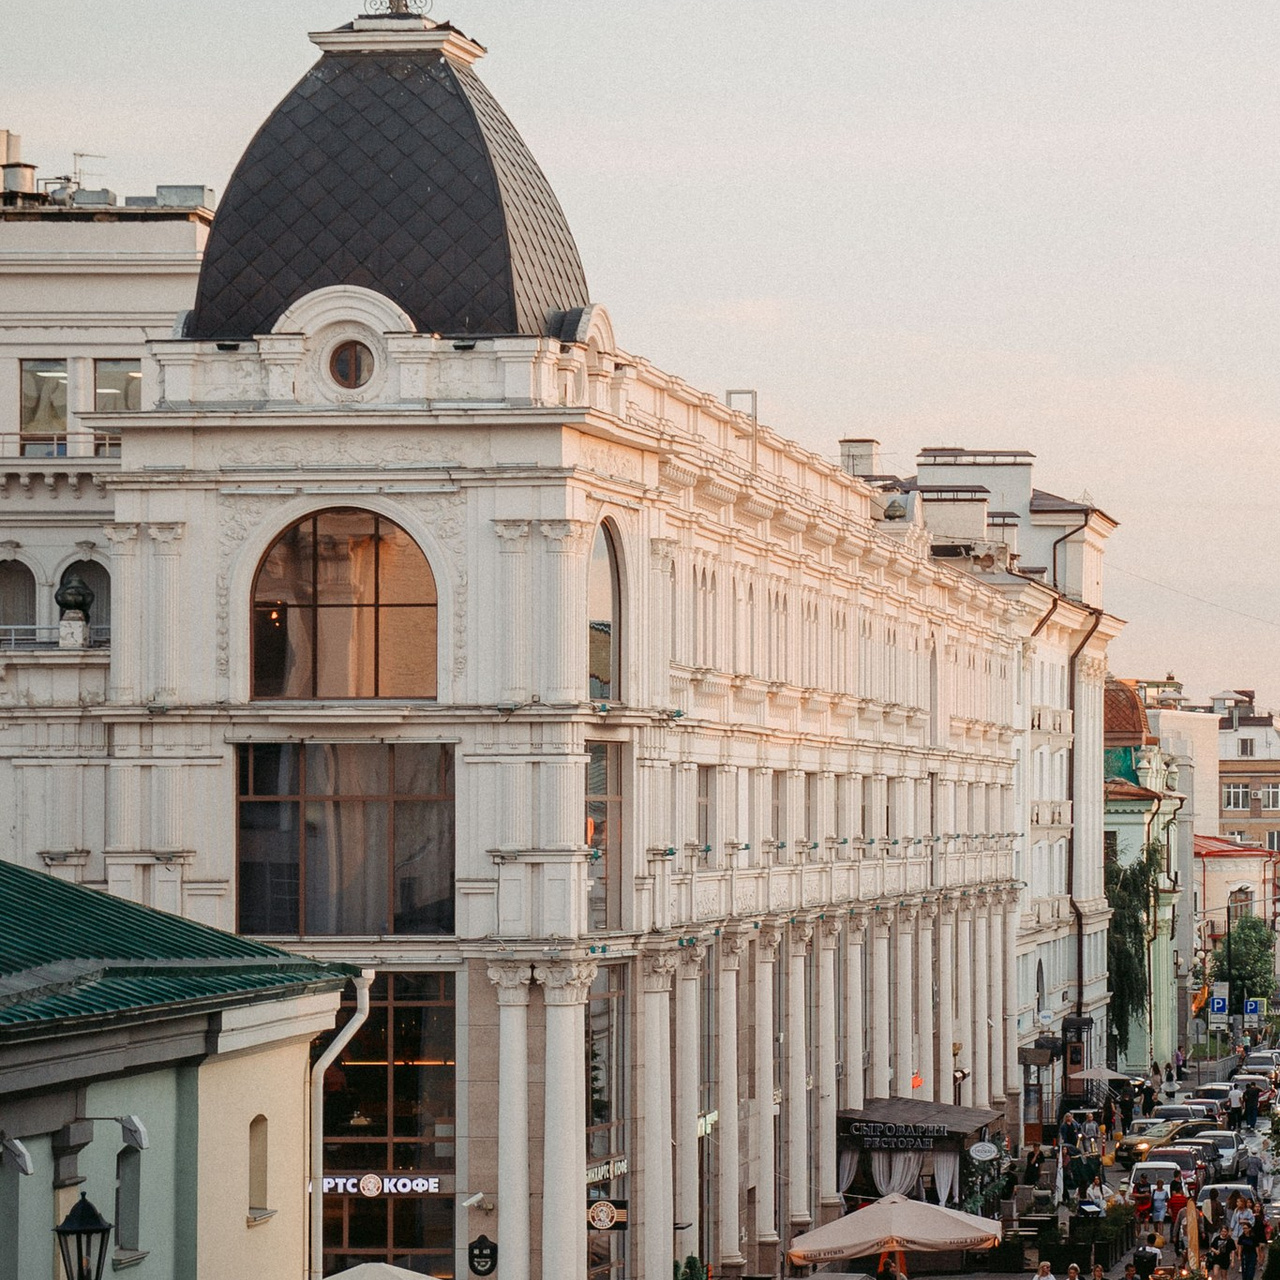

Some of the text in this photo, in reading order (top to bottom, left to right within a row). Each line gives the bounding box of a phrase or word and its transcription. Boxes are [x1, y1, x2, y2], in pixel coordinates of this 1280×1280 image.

[850, 1122, 948, 1136] СЫРОВАРНЯ
[864, 1137, 934, 1149] РЕСТОРАН
[308, 1178, 358, 1193] РТС
[383, 1177, 439, 1193] КОФЕ
